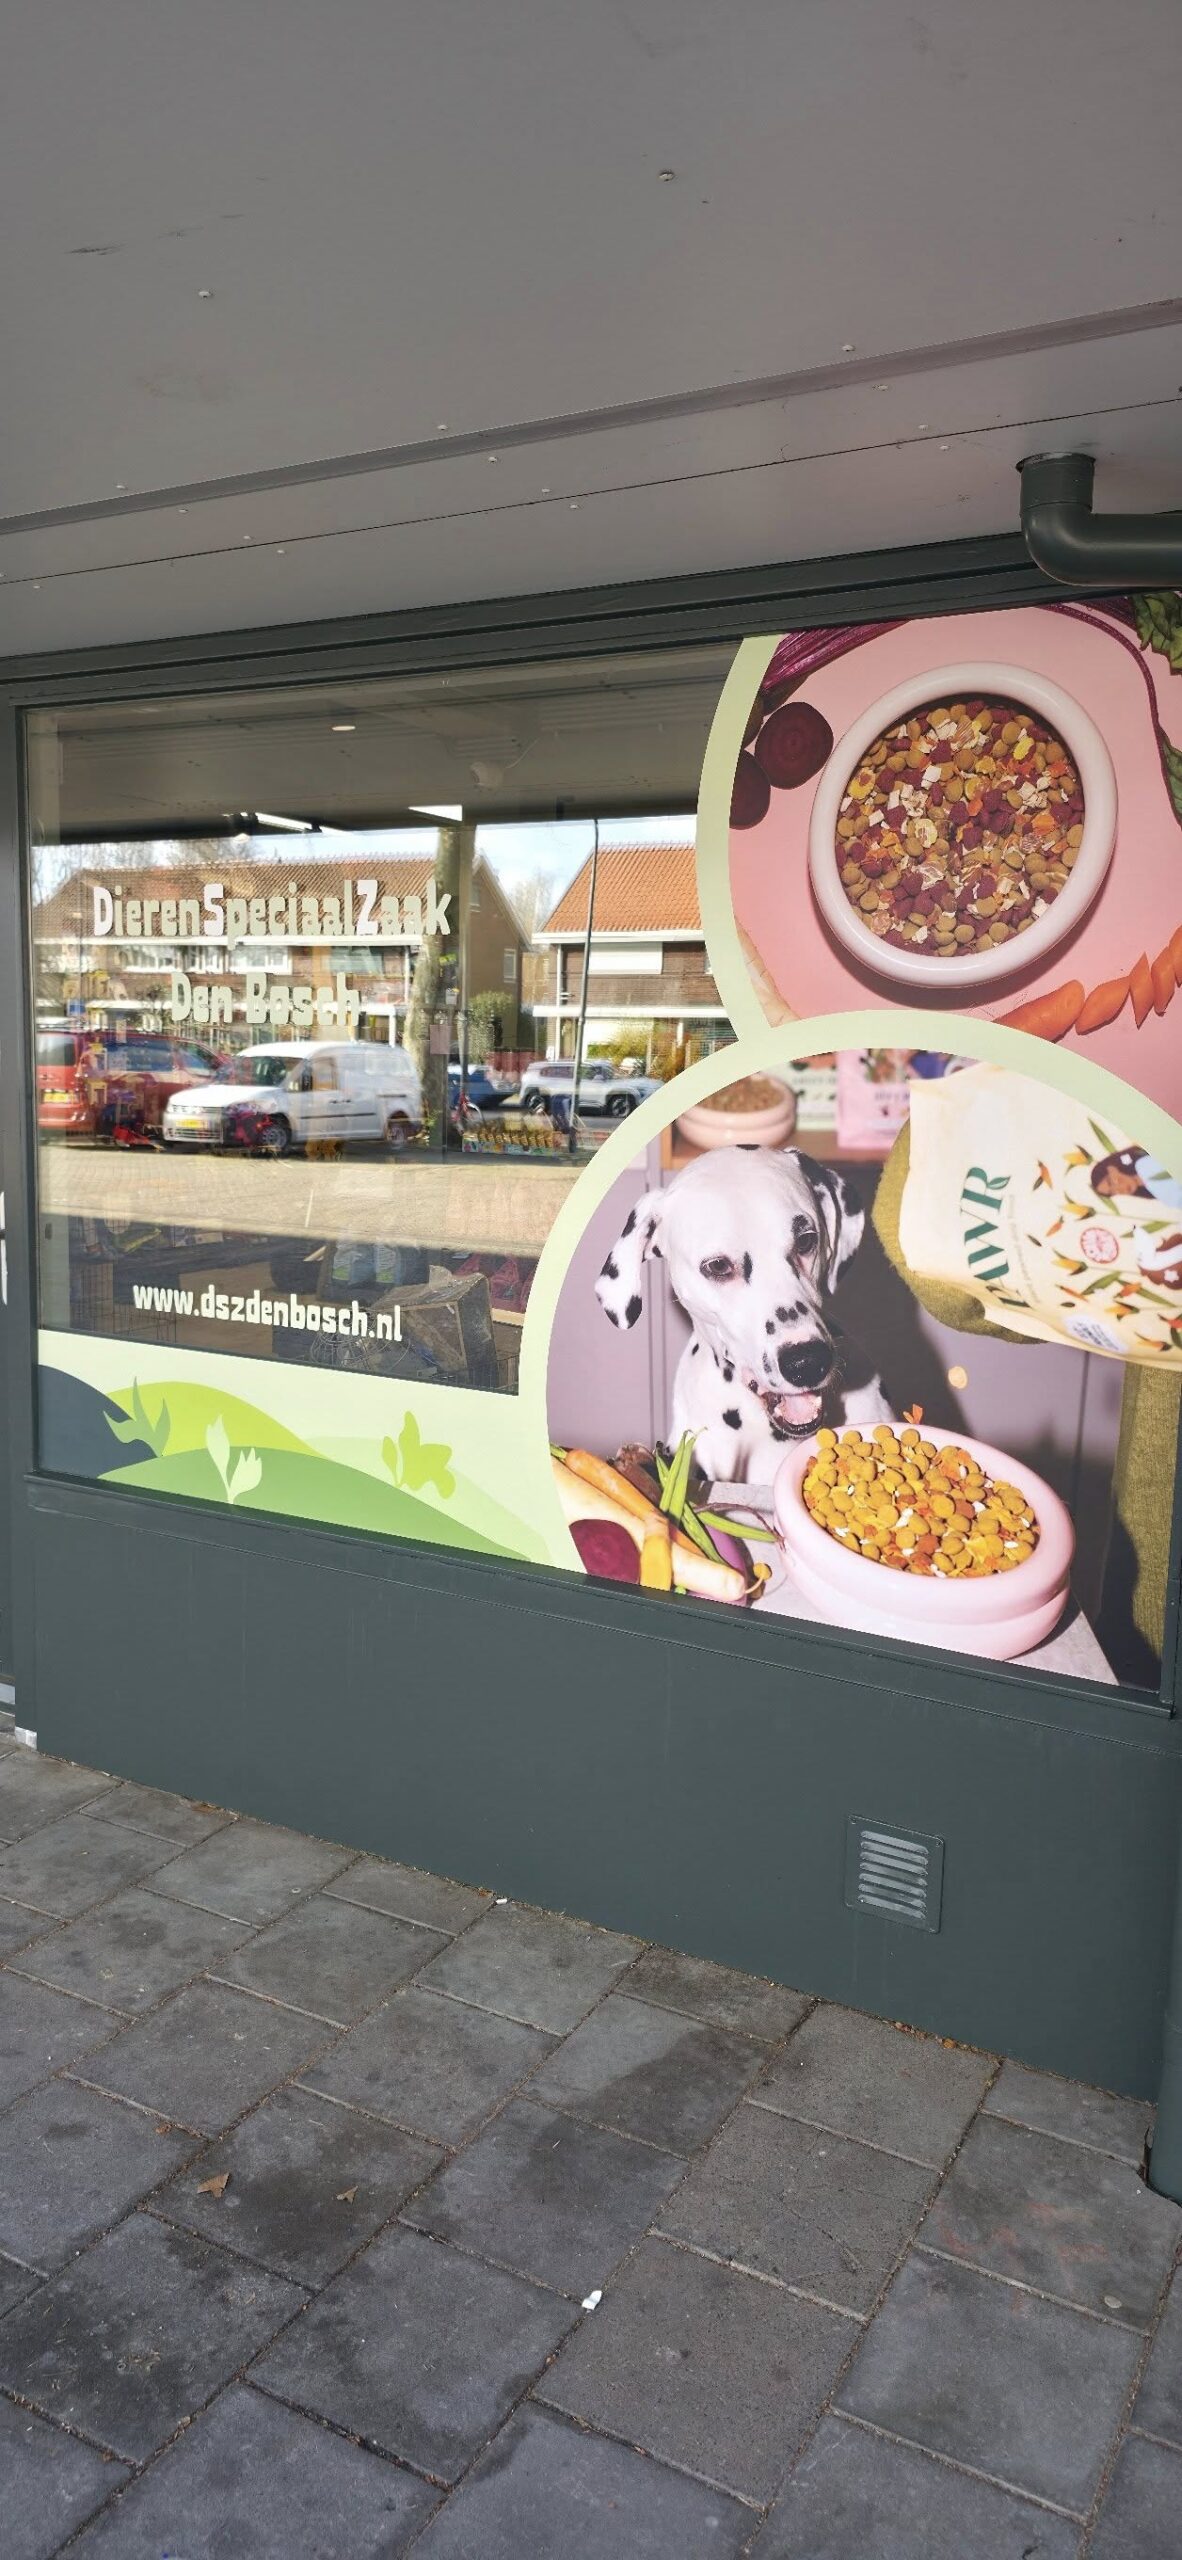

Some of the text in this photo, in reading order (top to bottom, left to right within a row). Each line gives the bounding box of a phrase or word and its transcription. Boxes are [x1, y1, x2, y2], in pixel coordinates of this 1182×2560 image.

[94, 879, 452, 950] DierenSpeciaalZaak
[171, 972, 361, 1026] Den Bosch
[133, 1284, 403, 1342] www.dszdenbosch.nl
